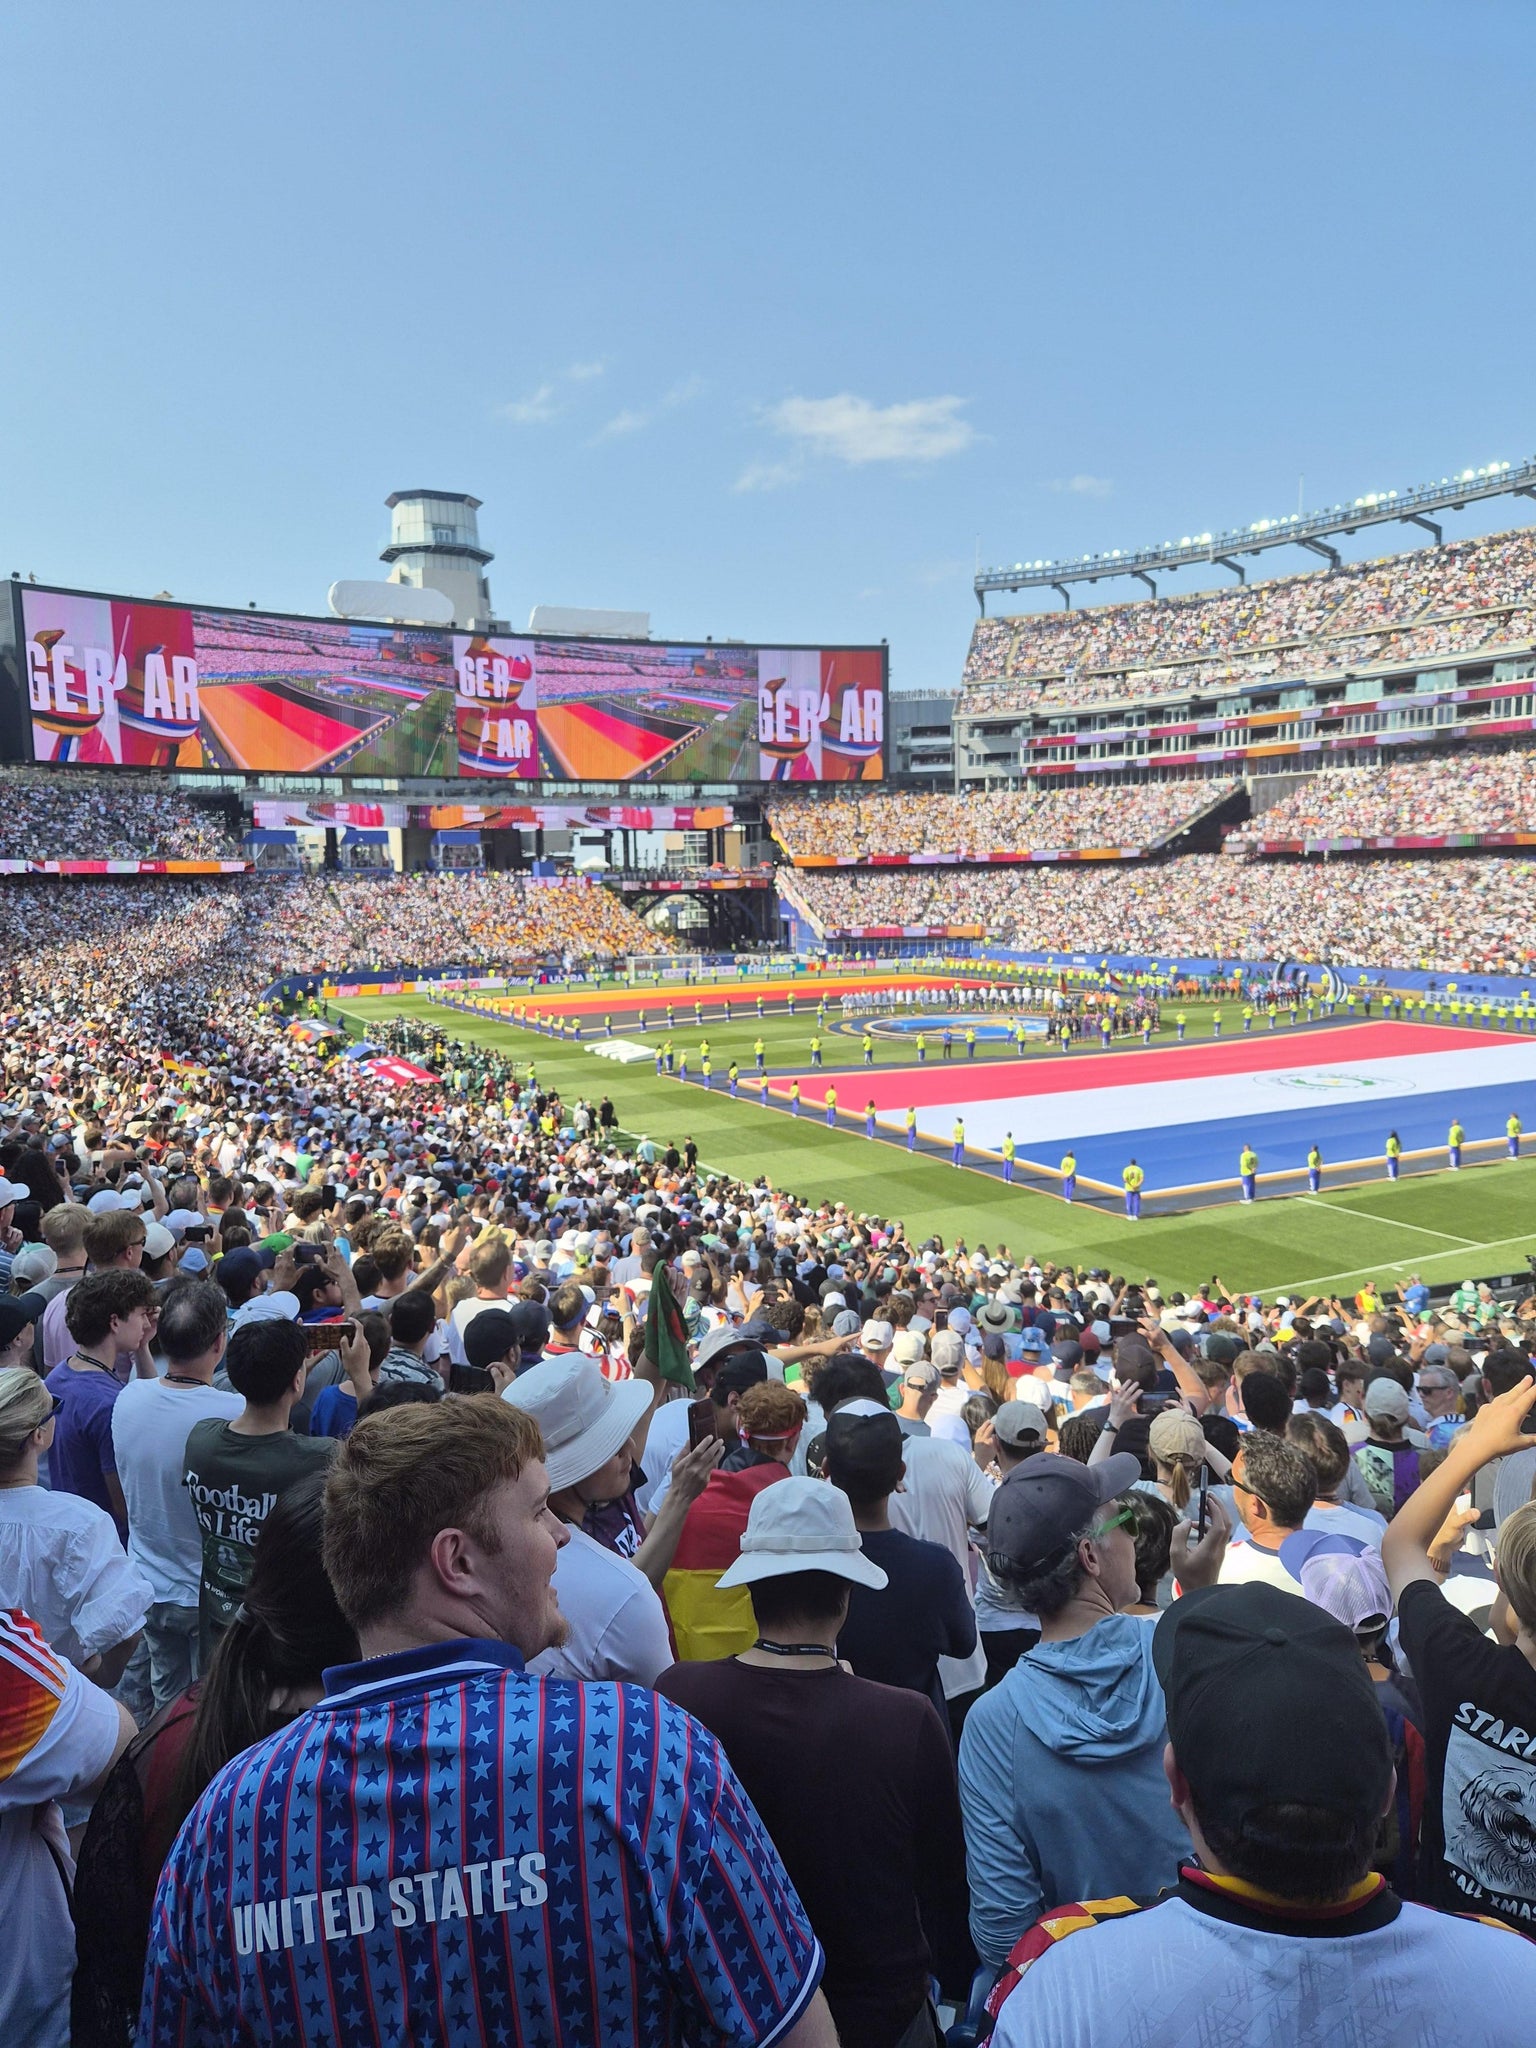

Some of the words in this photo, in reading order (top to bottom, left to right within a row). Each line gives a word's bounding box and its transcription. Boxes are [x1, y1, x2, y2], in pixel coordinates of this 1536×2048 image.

[459, 655, 511, 698] GER
[758, 688, 820, 742] GER
[186, 1469, 278, 1520] Football
[215, 1509, 261, 1547] Life
[232, 1884, 376, 1956] UNITED
[388, 1851, 549, 1928] STATES
